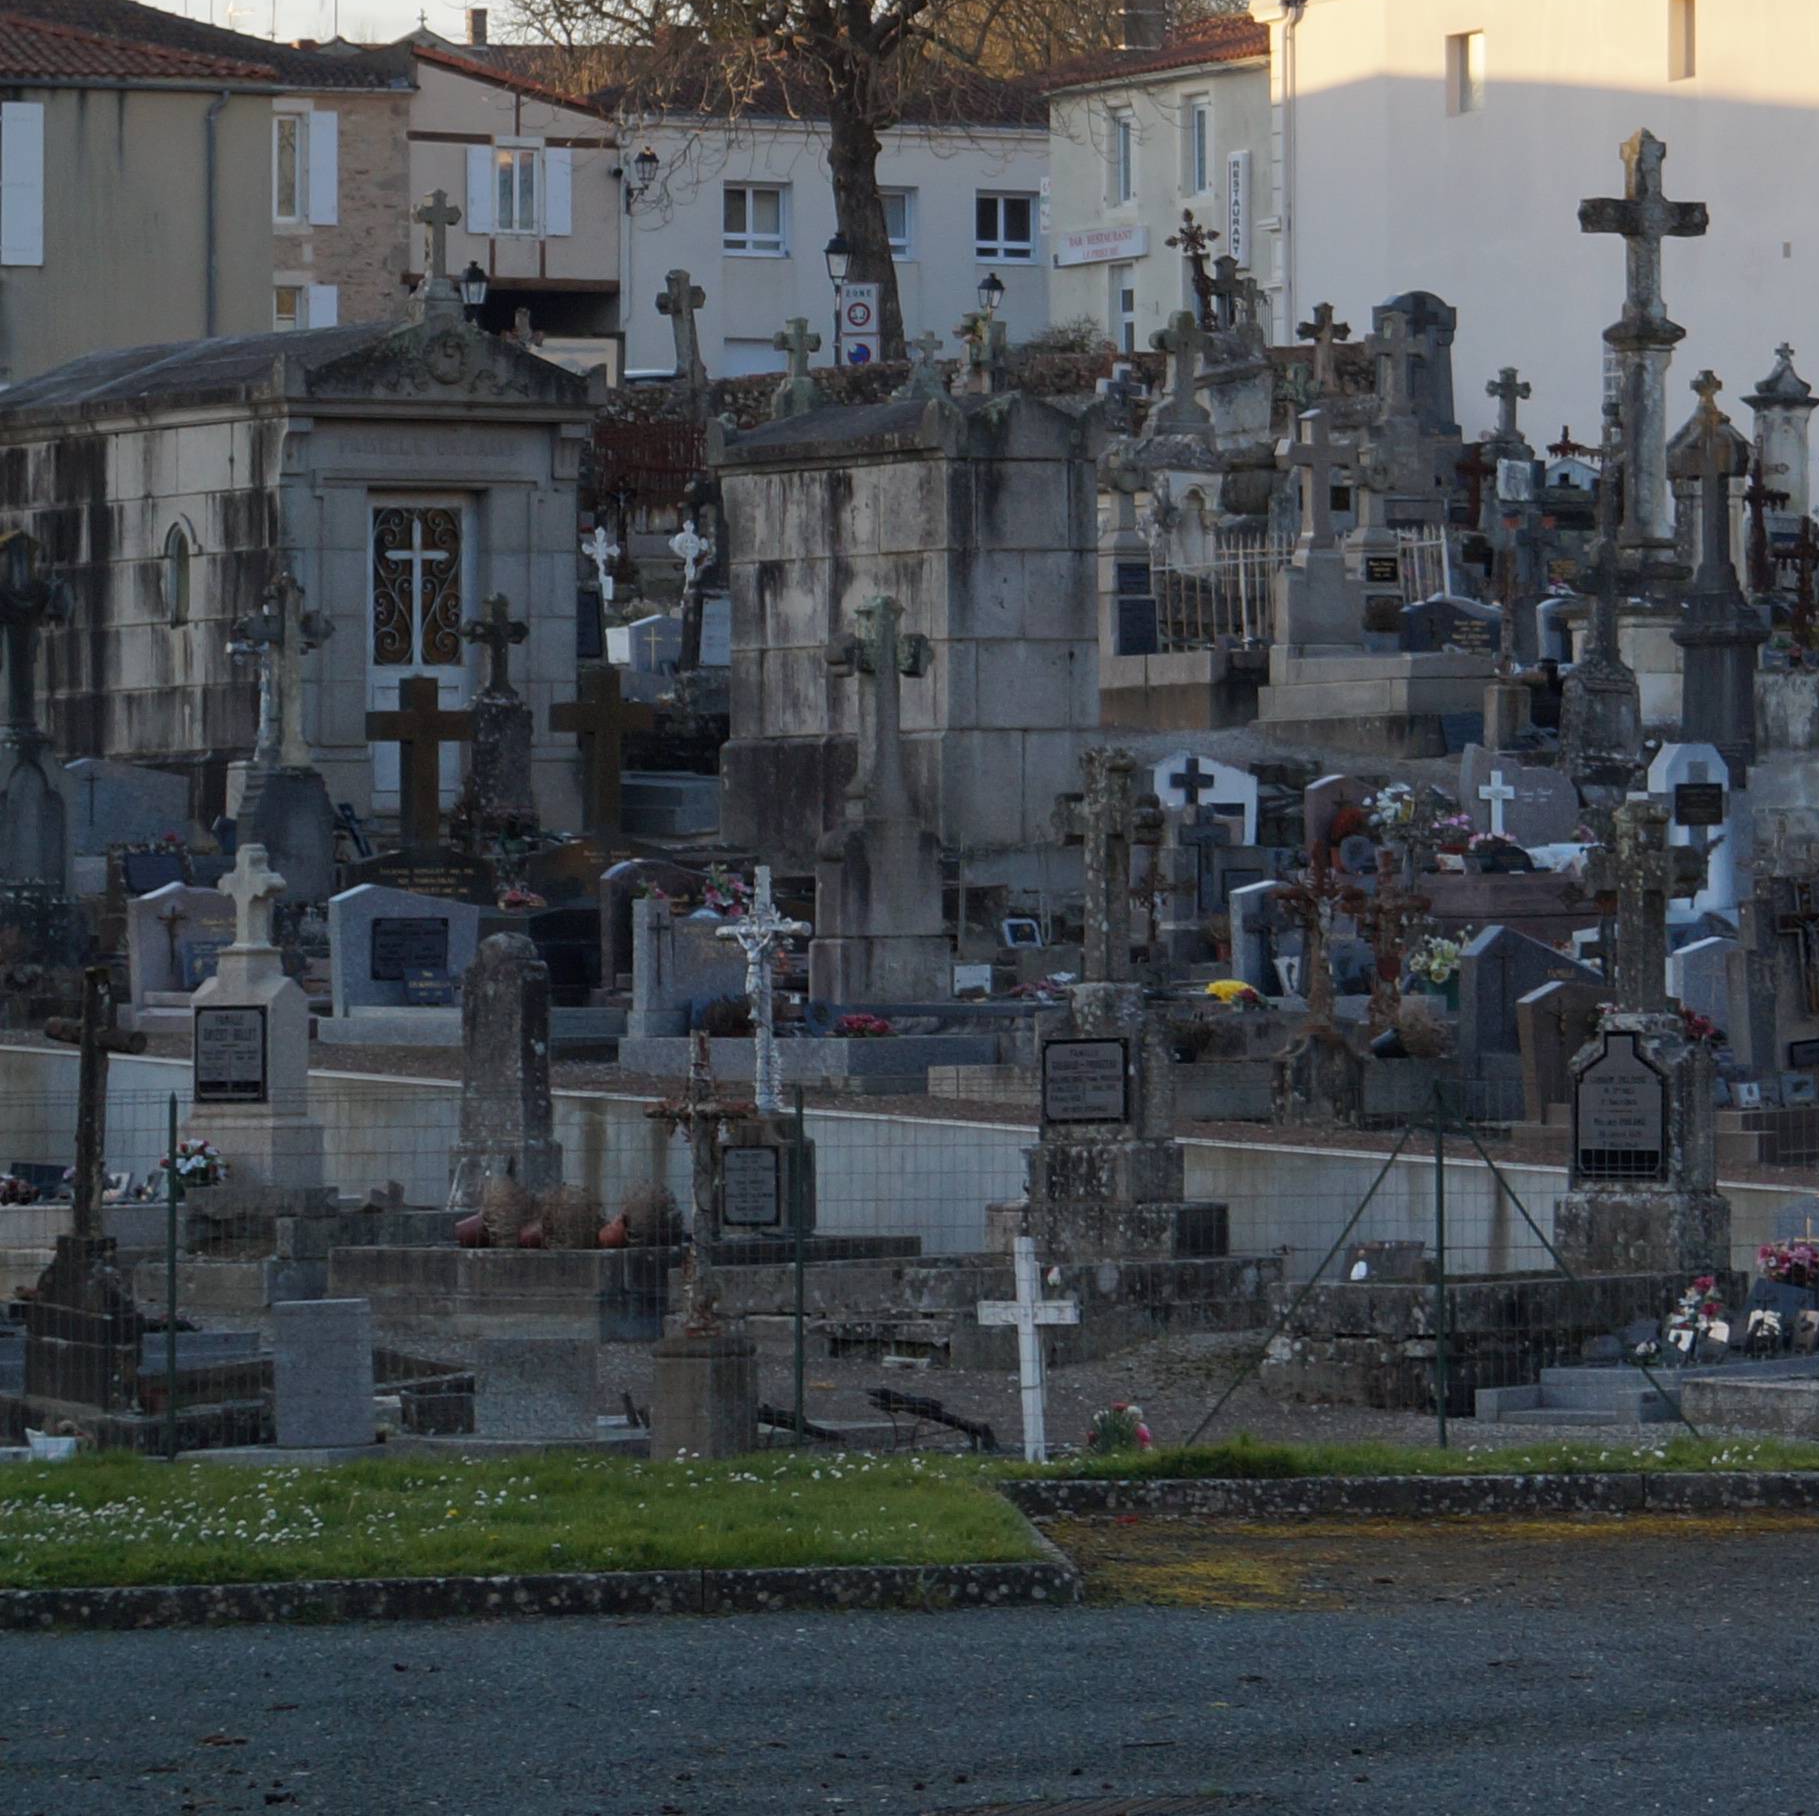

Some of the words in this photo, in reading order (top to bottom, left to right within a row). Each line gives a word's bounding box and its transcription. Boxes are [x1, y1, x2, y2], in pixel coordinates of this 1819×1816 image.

[1231, 160, 1241, 255] RESTAURANT
[1068, 235, 1083, 248] BAR
[1087, 230, 1133, 245] RESTAURANT
[845, 289, 872, 297] ZONE
